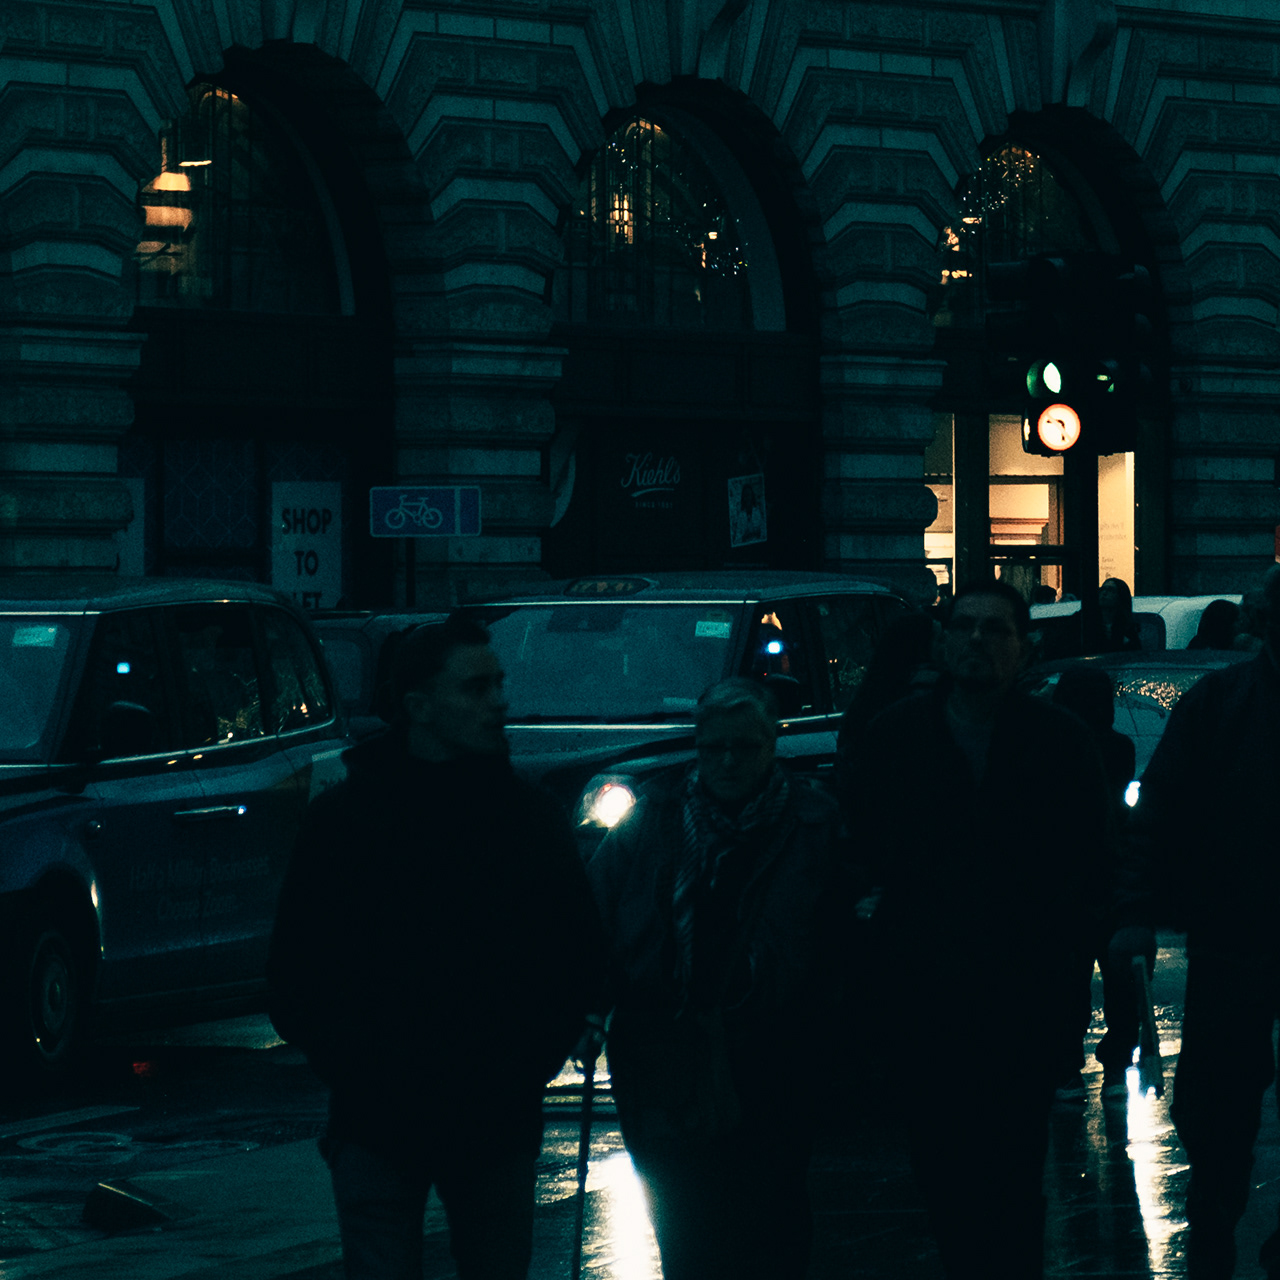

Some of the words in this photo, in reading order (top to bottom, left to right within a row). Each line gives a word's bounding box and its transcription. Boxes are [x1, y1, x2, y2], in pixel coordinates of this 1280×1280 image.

[620, 451, 682, 488] Kiehl's
[281, 508, 333, 535] SHOP
[294, 550, 320, 577] TO
